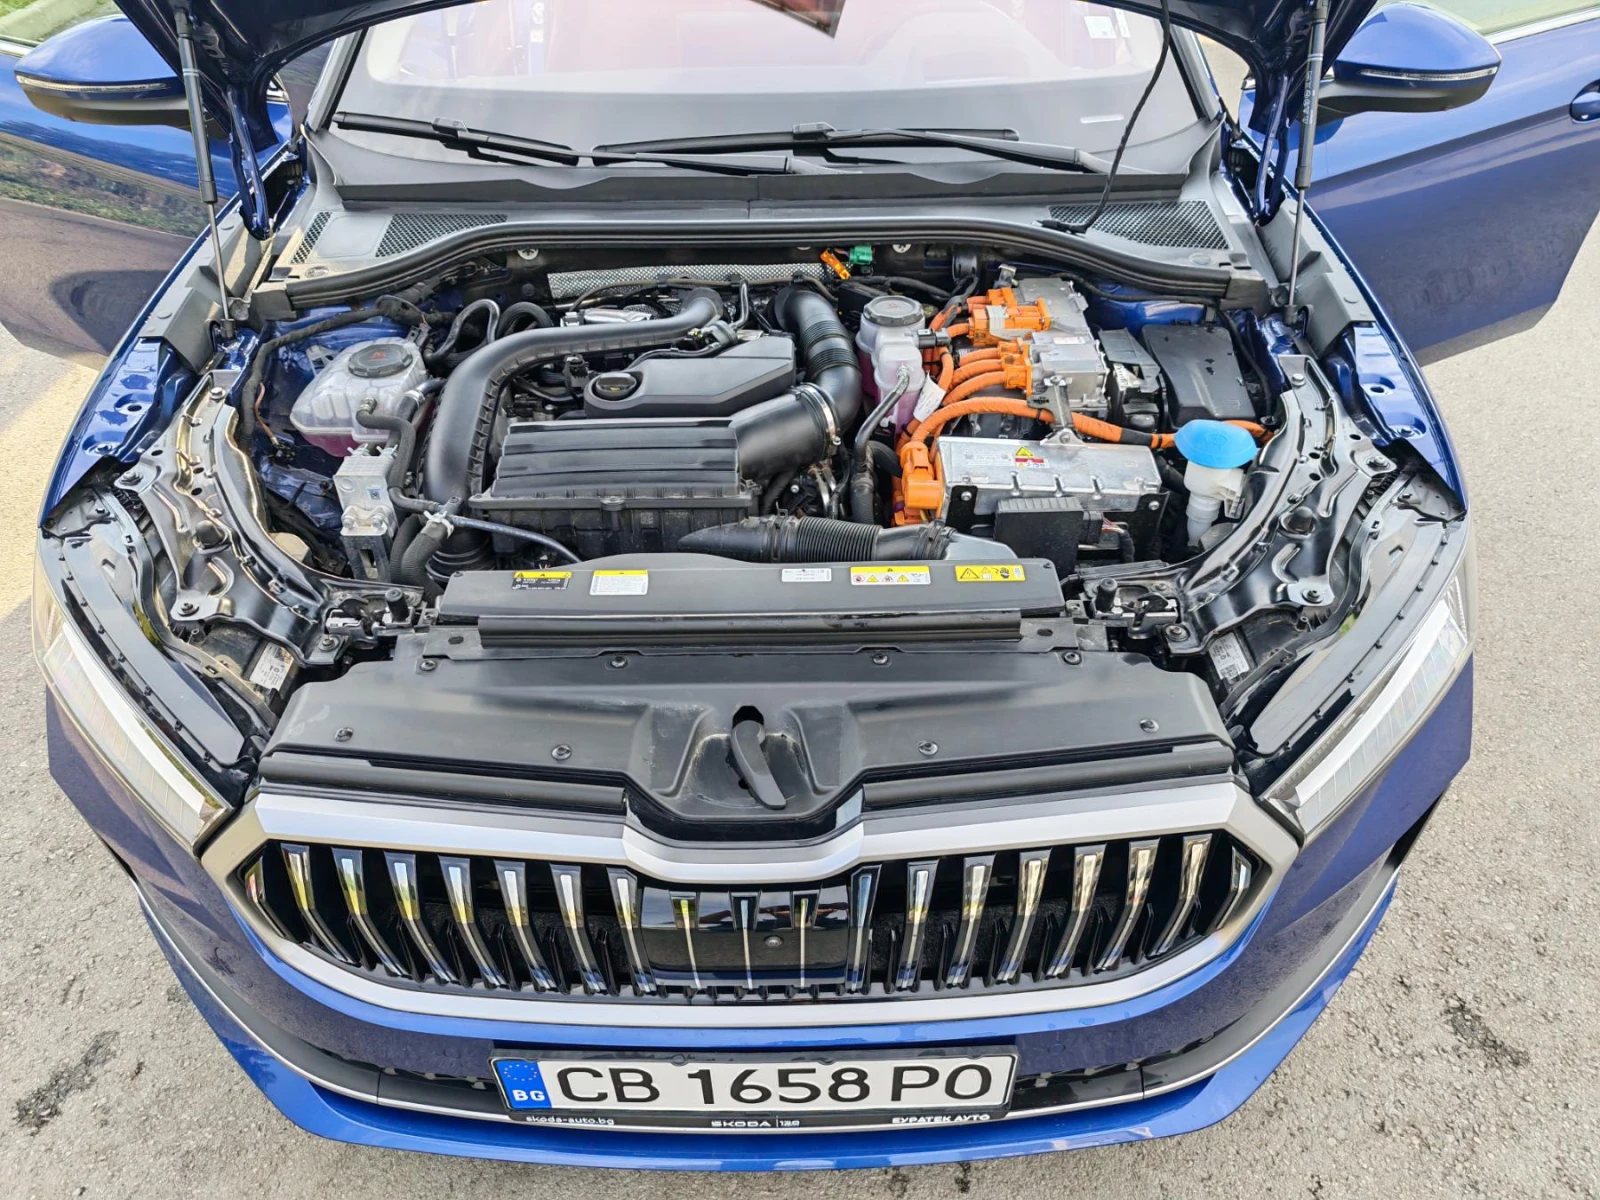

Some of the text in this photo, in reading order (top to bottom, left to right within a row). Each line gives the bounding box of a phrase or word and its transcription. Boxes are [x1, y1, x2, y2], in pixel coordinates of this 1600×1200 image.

[556, 1064, 992, 1105] CB 1658 PO
[512, 1089, 546, 1102] BG
[525, 1115, 615, 1126] skoda-auto.bg
